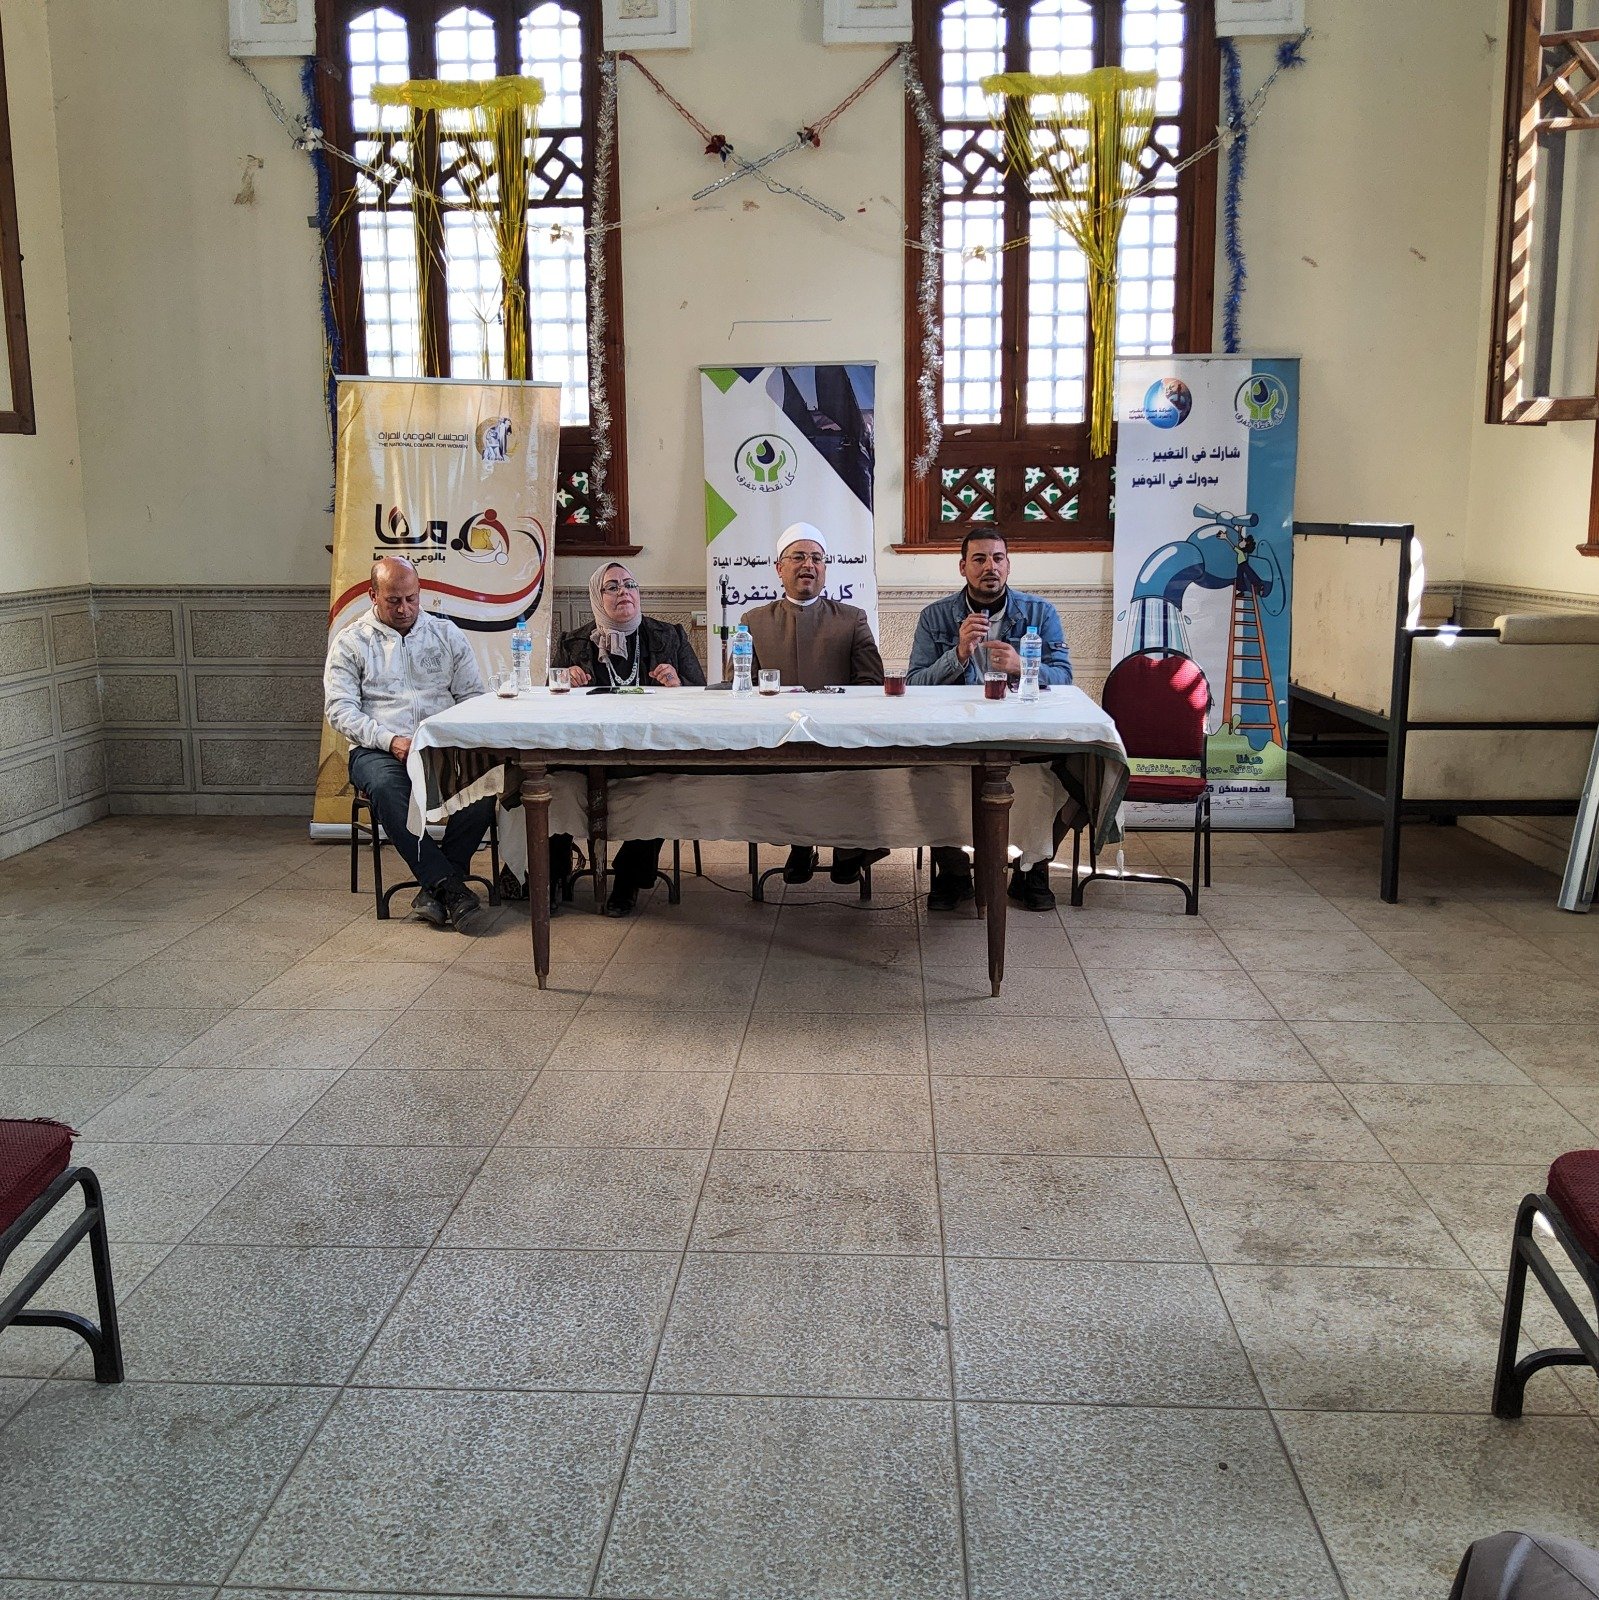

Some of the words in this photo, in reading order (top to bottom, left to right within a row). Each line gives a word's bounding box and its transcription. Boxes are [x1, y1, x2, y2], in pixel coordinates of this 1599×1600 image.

[402, 432, 436, 441] القومي
[438, 433, 469, 442] المجلس
[1152, 446, 1188, 462] التغيير
[1191, 447, 1207, 464] في
[1209, 446, 1240, 462] شارك
[736, 474, 757, 493] بتفرق
[759, 480, 784, 493] نقطة
[784, 471, 795, 487] كل
[1131, 472, 1165, 488] التوفير
[1168, 473, 1183, 489] في
[1186, 472, 1219, 487] بدورك
[411, 552, 446, 567] بالوعي
[838, 553, 867, 565] الحملة
[830, 583, 854, 603] كل
[1205, 766, 1222, 775] جود
[1205, 784, 1214, 793] 25
[1248, 785, 1270, 793] الخط
